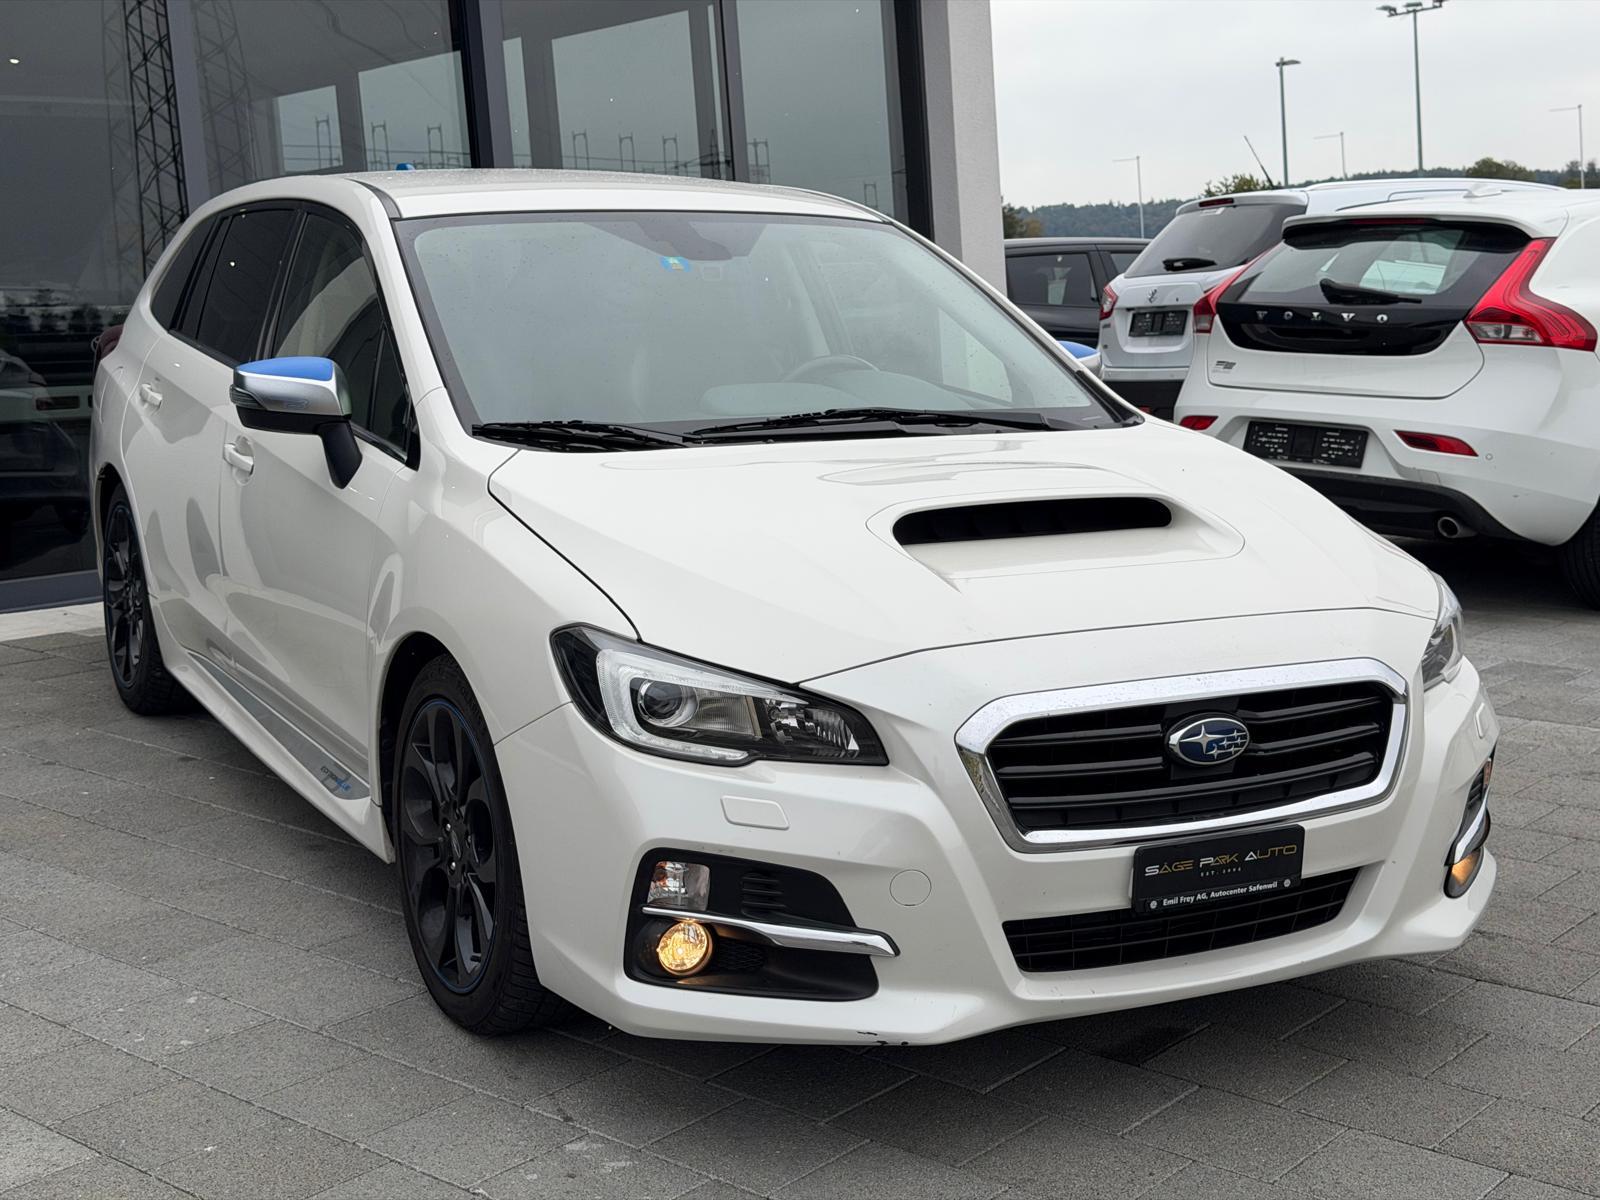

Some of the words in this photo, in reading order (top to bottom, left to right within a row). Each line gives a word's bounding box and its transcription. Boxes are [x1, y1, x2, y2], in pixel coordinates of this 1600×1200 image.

[1255, 310, 1389, 324] VOLVO
[1200, 853, 1239, 867] PARK
[1245, 844, 1297, 861] AUTO
[1163, 896, 1178, 906] Emil
[1180, 893, 1195, 905] Frey
[1196, 891, 1208, 901] AG,
[1210, 887, 1247, 898] Autocenter
[1249, 881, 1278, 892] Safenwil
